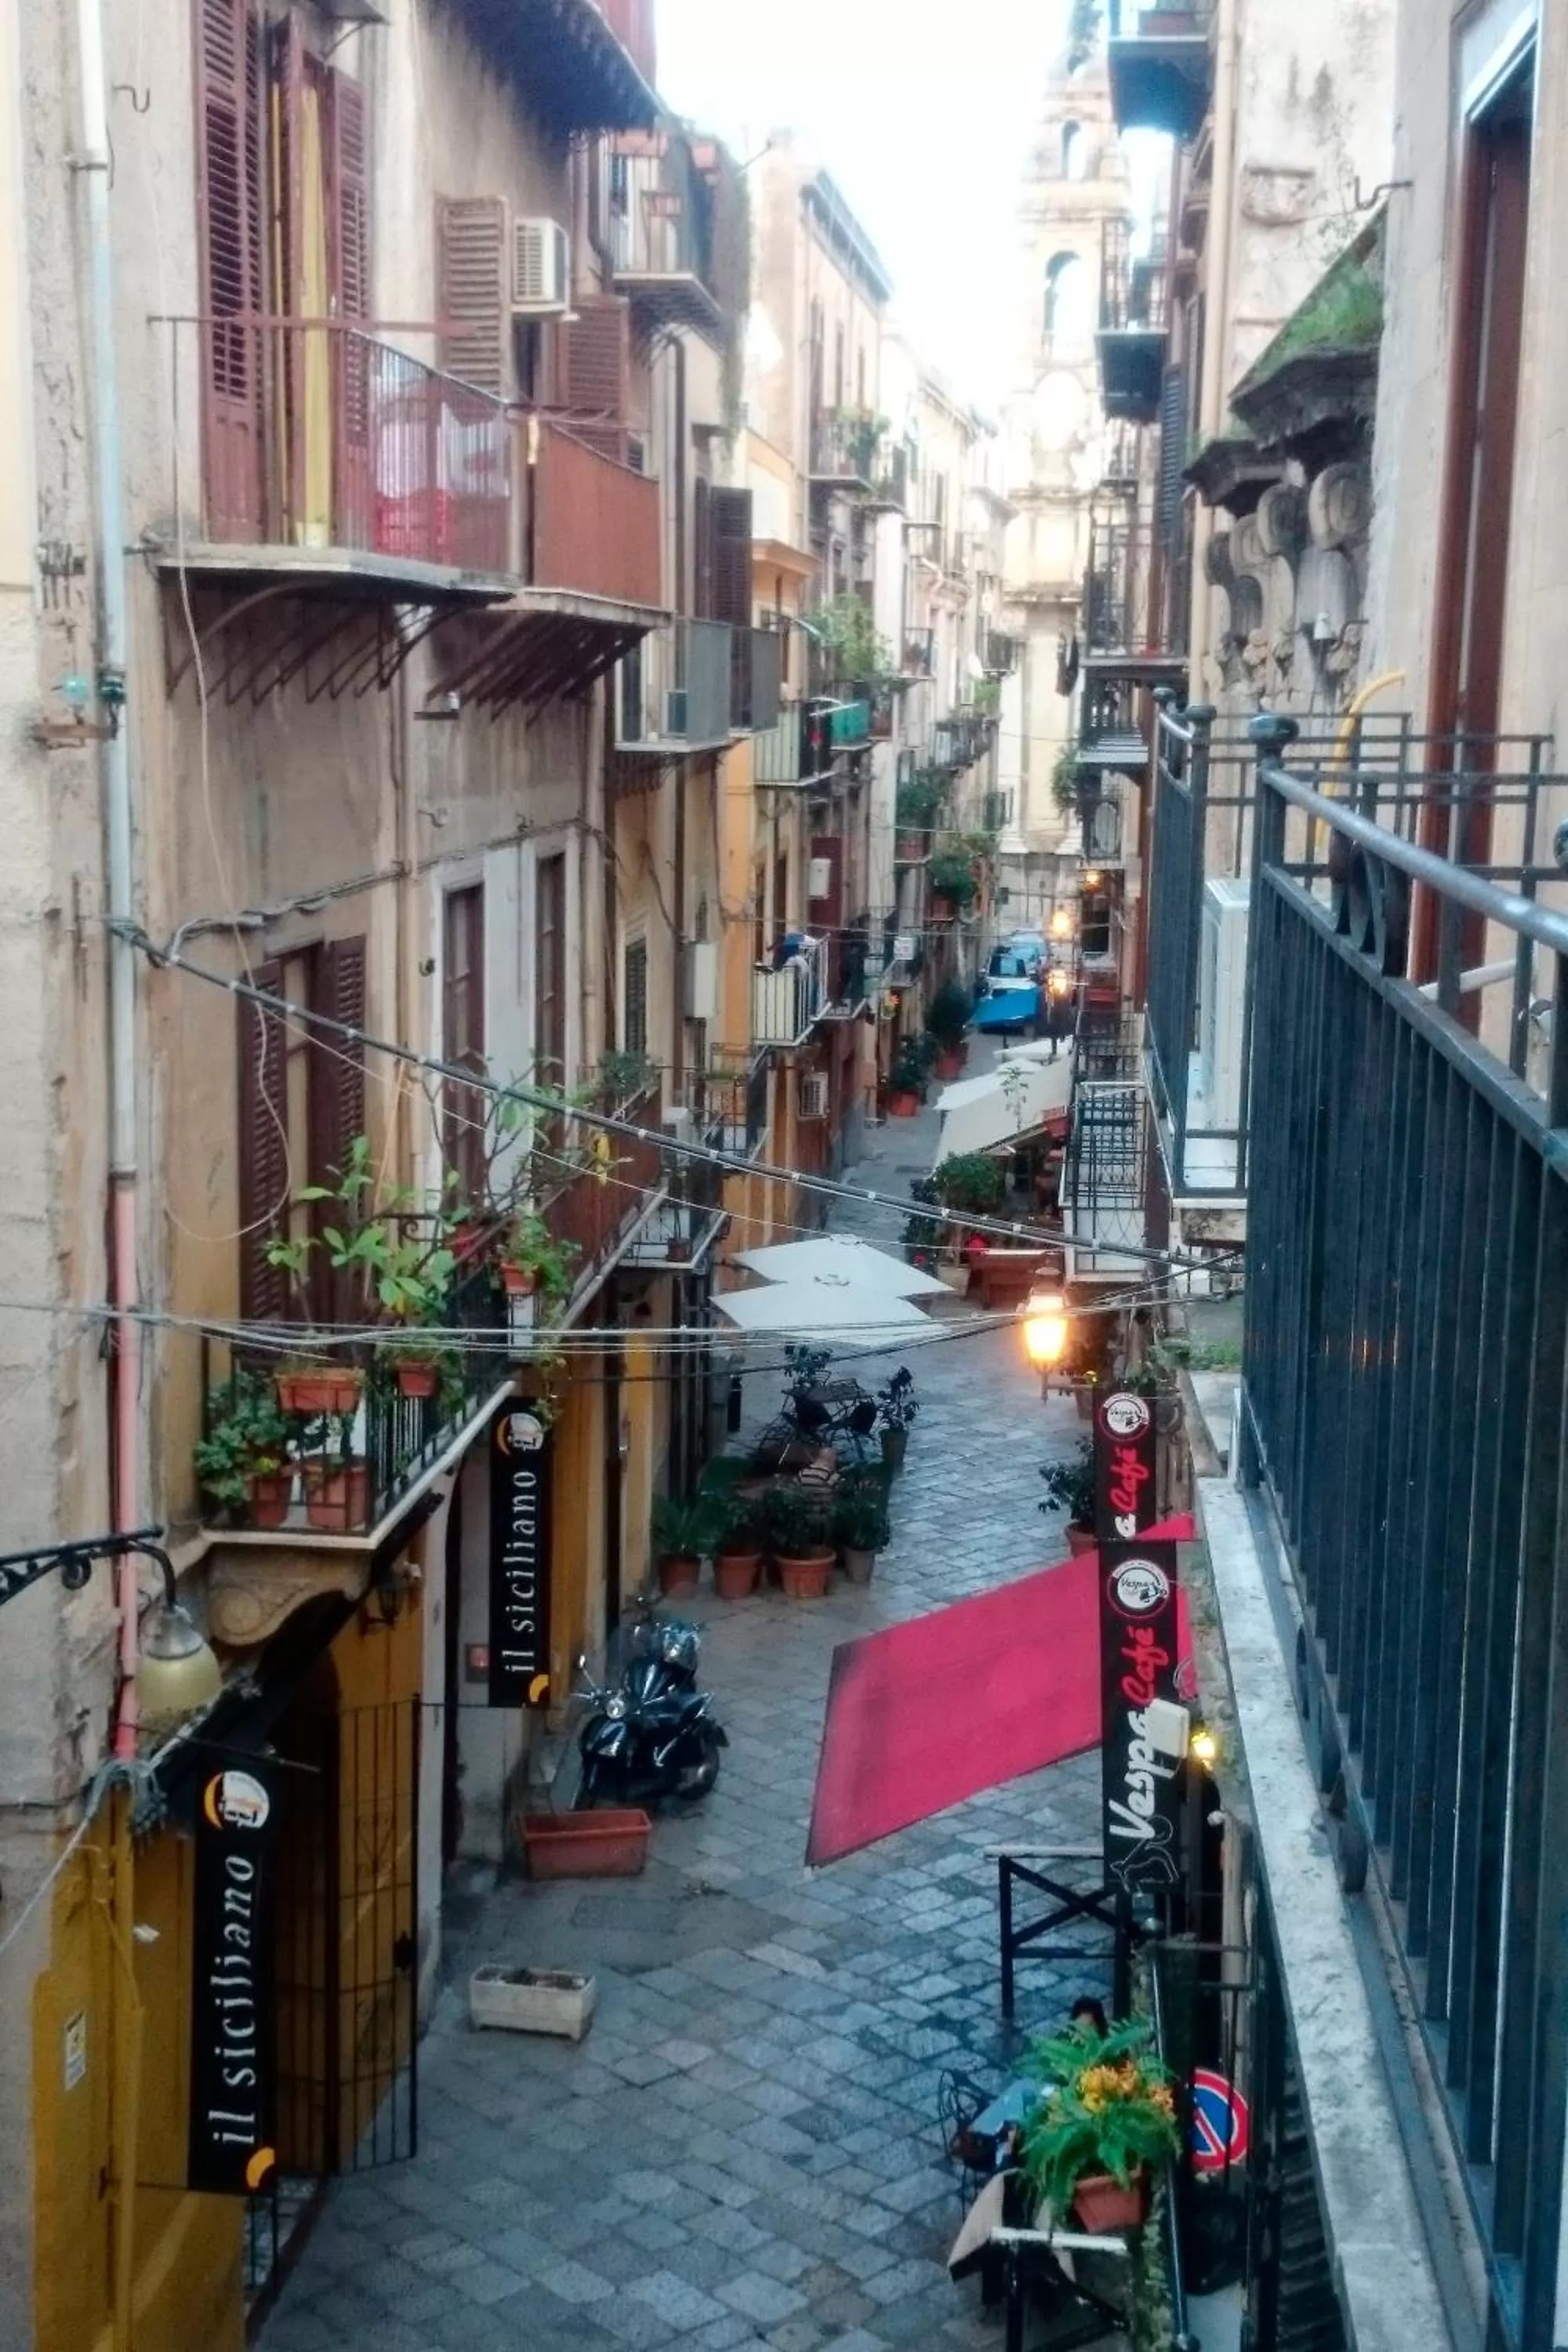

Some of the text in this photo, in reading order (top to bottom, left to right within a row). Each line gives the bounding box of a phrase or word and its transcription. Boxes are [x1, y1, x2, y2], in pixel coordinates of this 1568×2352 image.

[503, 1471, 537, 1632] siciliano
[502, 1650, 535, 1672] il
[1120, 1625, 1169, 1706] Café
[1108, 1708, 1175, 1839] Vespa
[210, 1855, 255, 2087] siciliano
[208, 2111, 255, 2145] il
